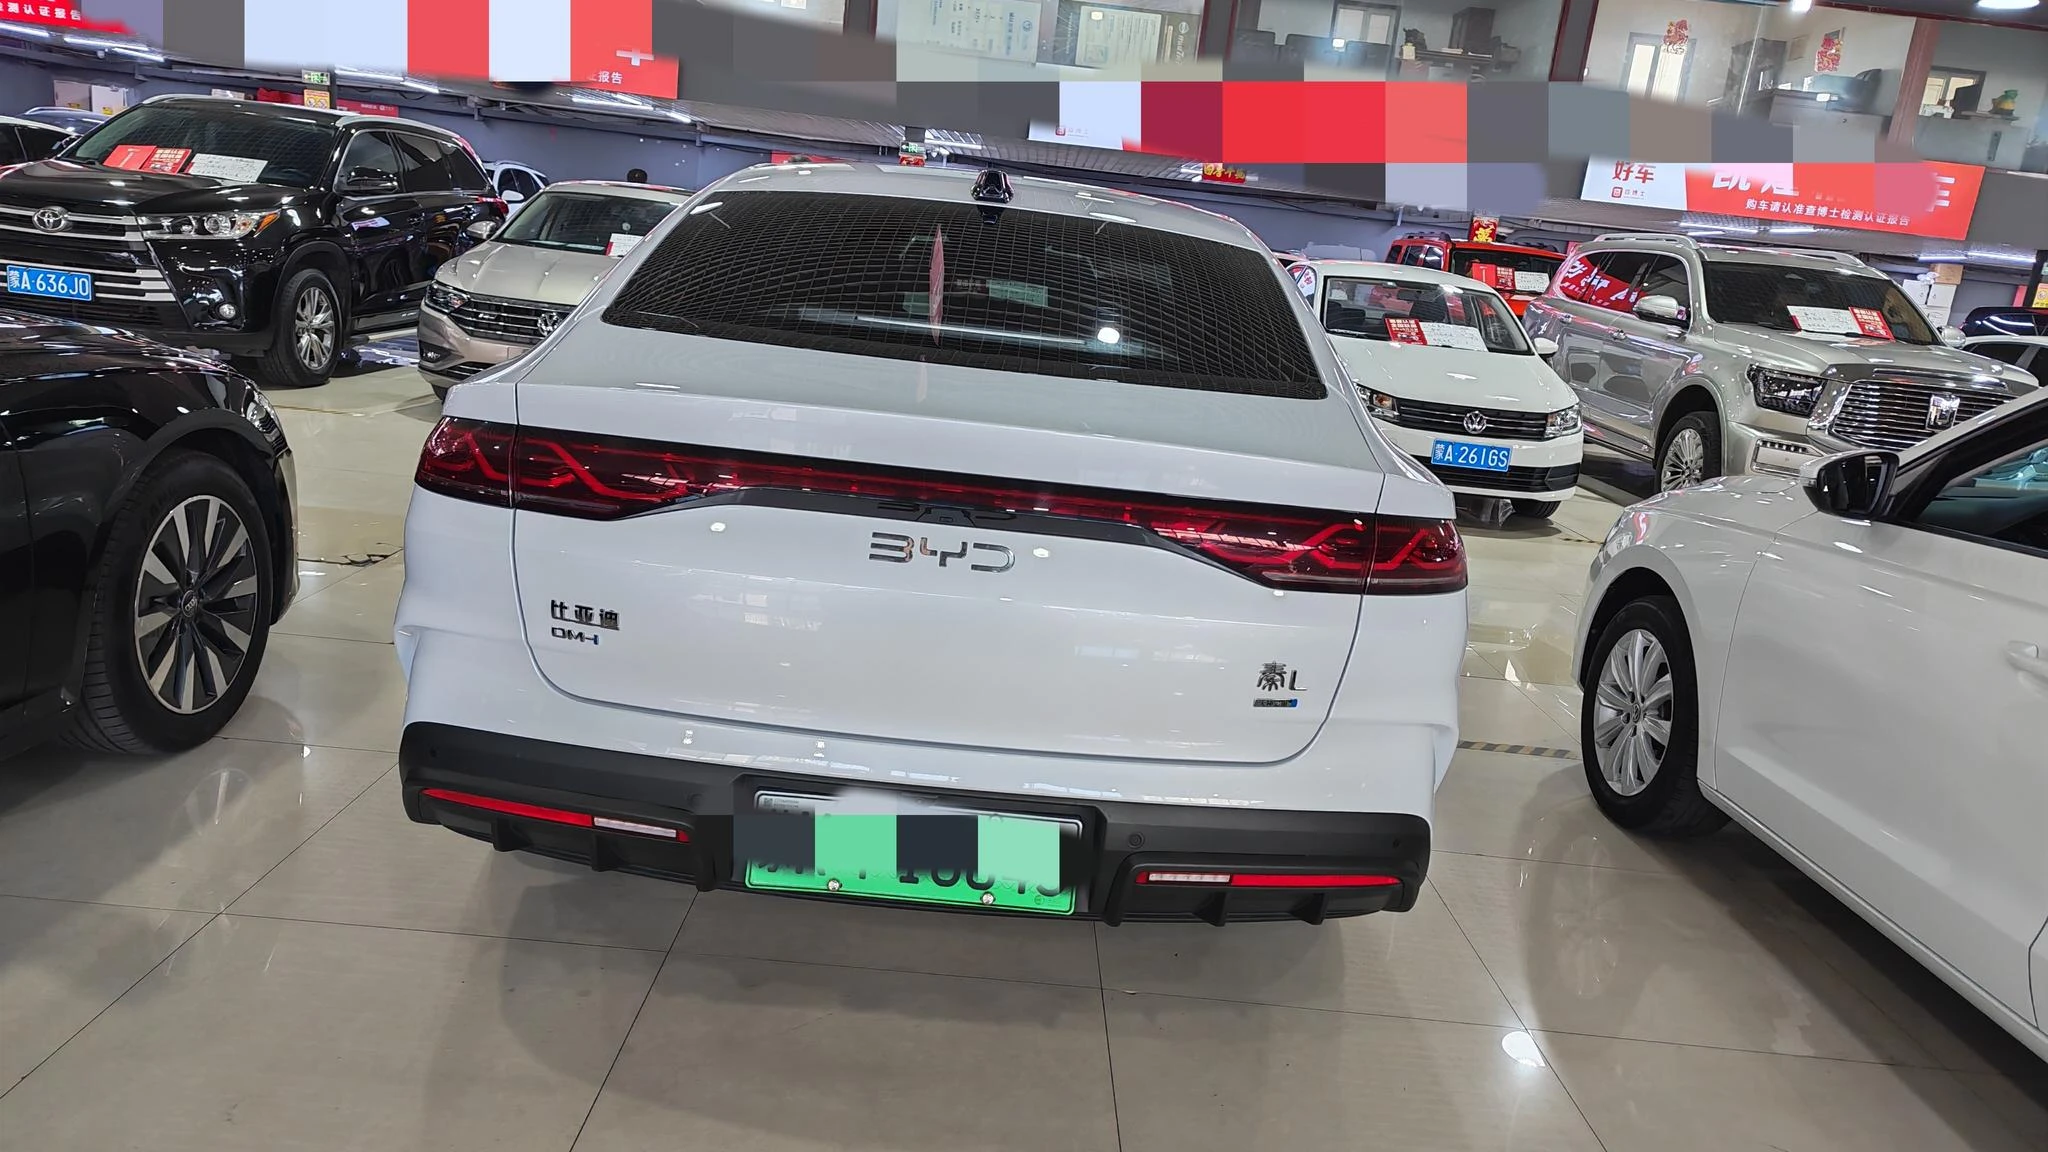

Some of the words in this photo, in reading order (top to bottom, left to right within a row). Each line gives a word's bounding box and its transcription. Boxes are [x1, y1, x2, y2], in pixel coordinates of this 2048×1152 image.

[0, 2, 81, 20] 测认证报告
[868, 531, 1016, 574] BYD
[550, 599, 620, 631] 比亚迪
